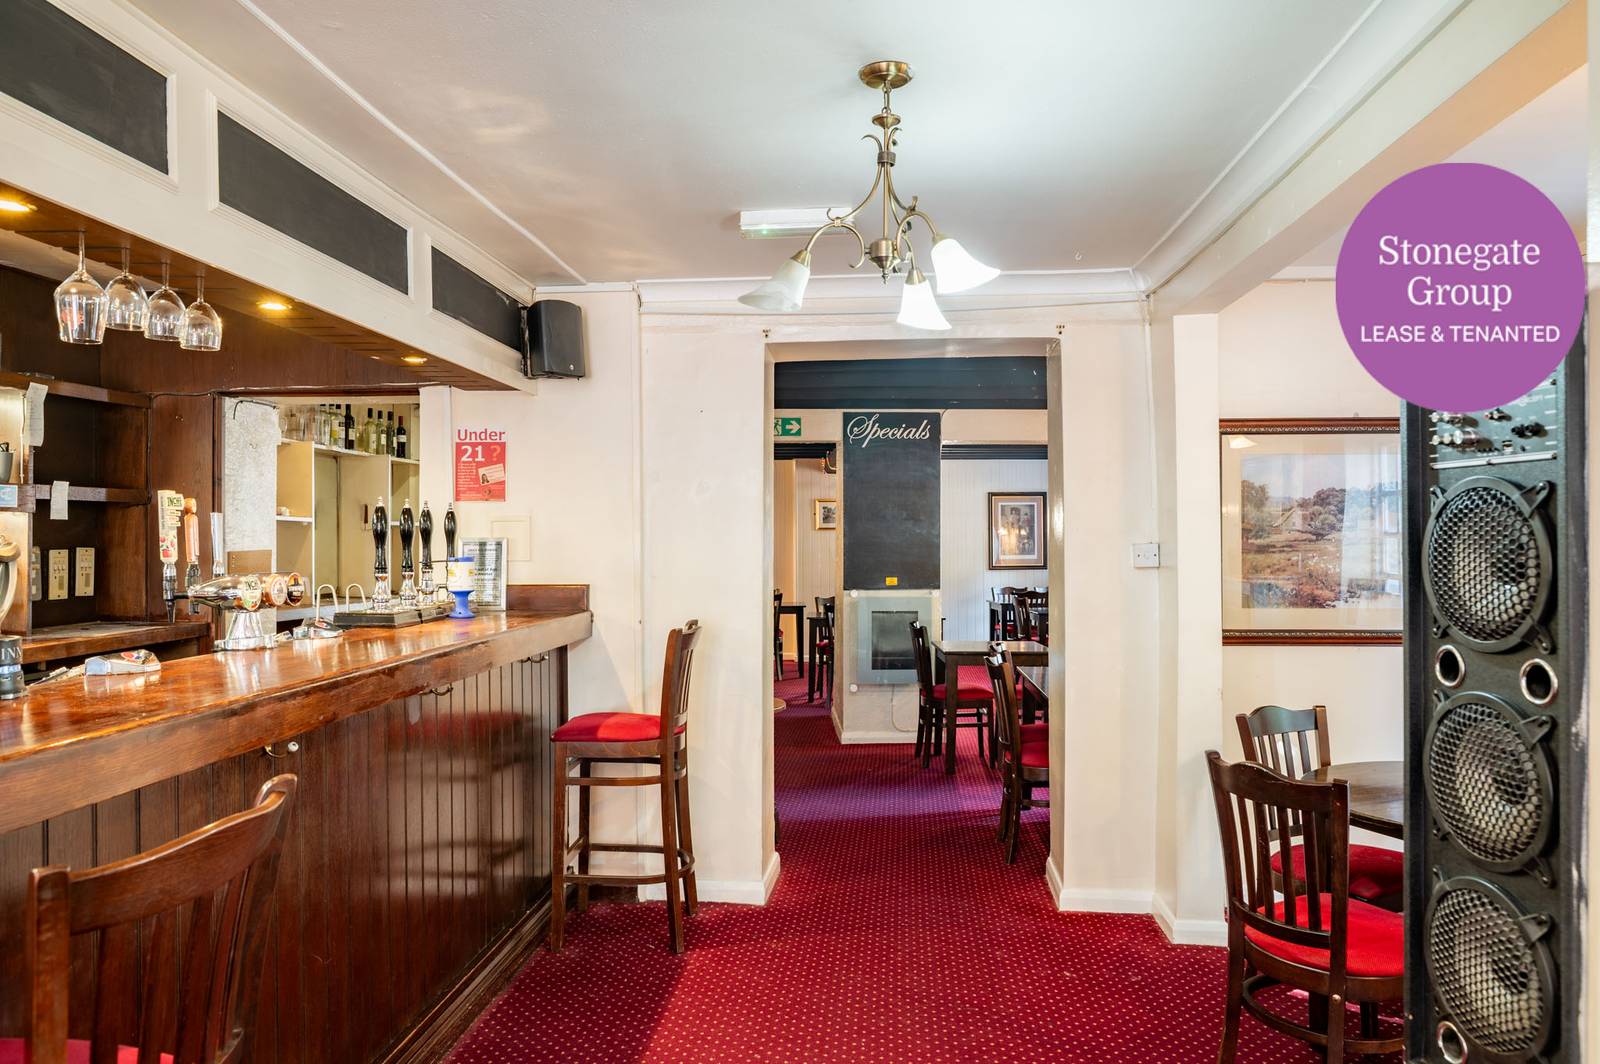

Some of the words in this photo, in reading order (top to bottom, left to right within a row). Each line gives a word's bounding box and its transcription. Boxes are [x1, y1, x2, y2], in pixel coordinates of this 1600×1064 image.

[457, 428, 505, 441] Under
[847, 413, 930, 447] Specials
[460, 445, 485, 462] 21
